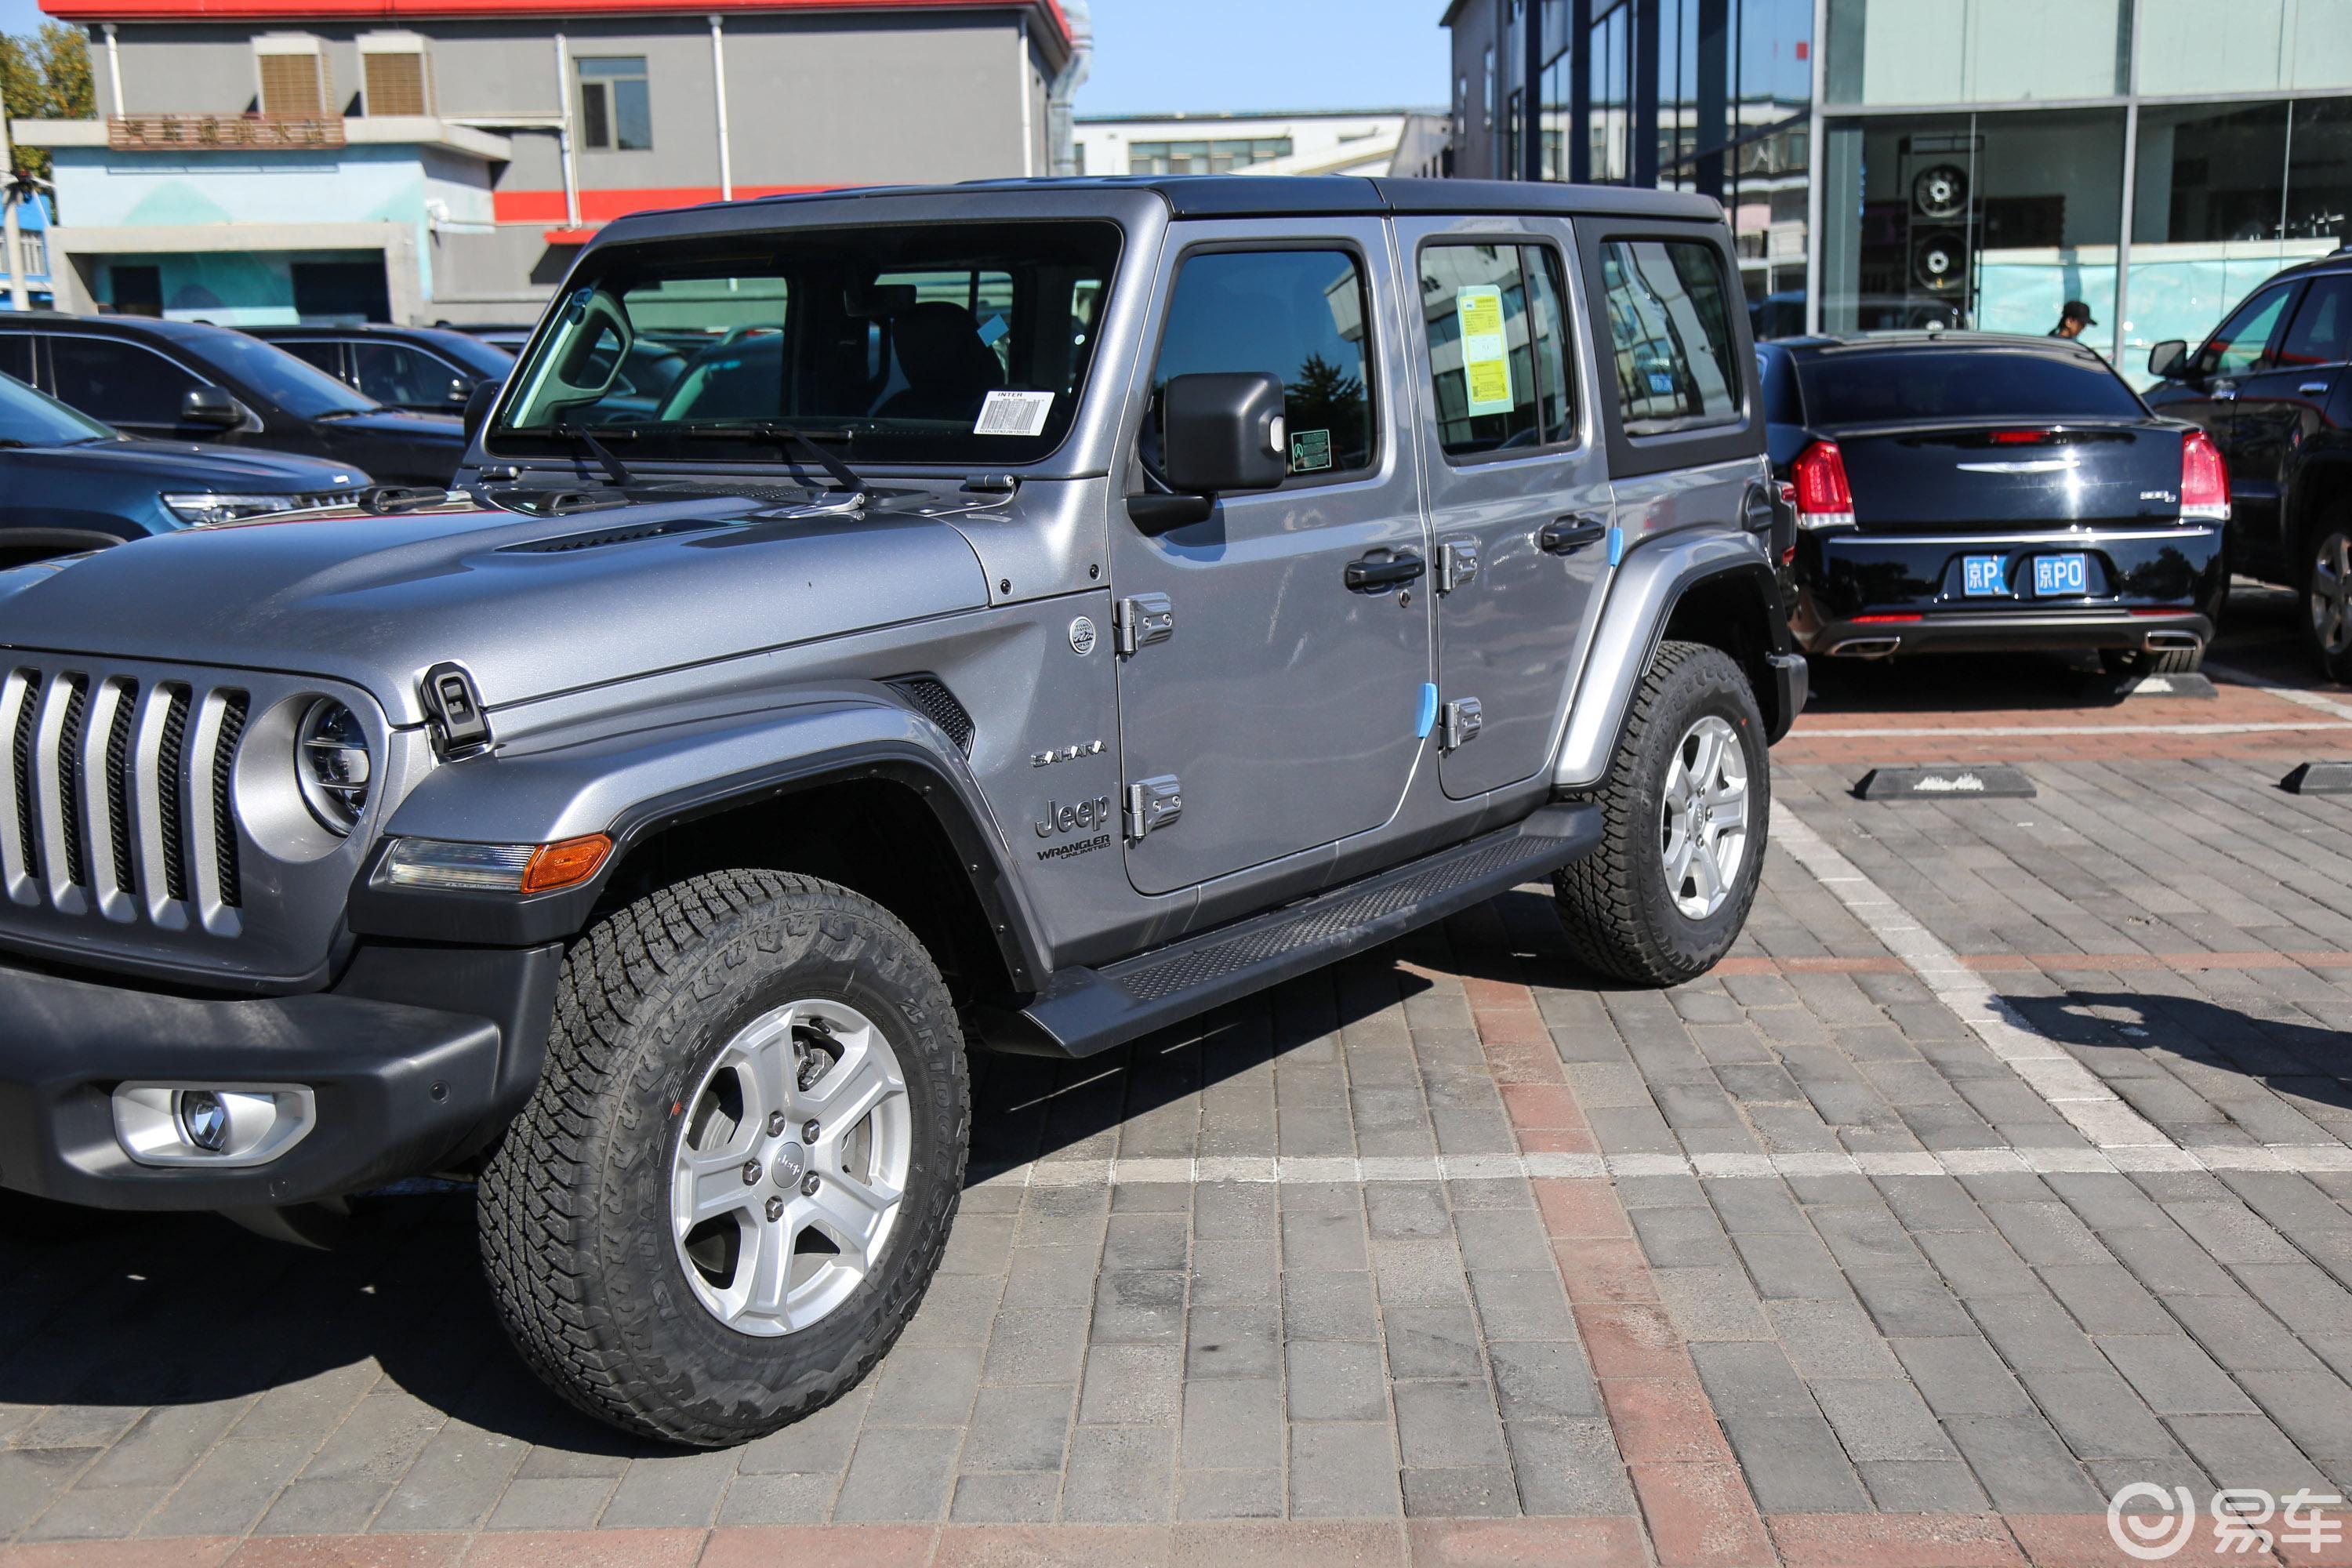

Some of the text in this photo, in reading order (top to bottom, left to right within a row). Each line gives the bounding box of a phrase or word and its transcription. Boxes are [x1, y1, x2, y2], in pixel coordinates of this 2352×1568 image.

[1031, 740, 1108, 768] SAHARA
[1035, 795, 1110, 838] Jeep
[1036, 833, 1111, 861] WRANGLER
[1061, 842, 1111, 860] UNLIMITED
[862, 996, 952, 1342] BRIDGESTONE
